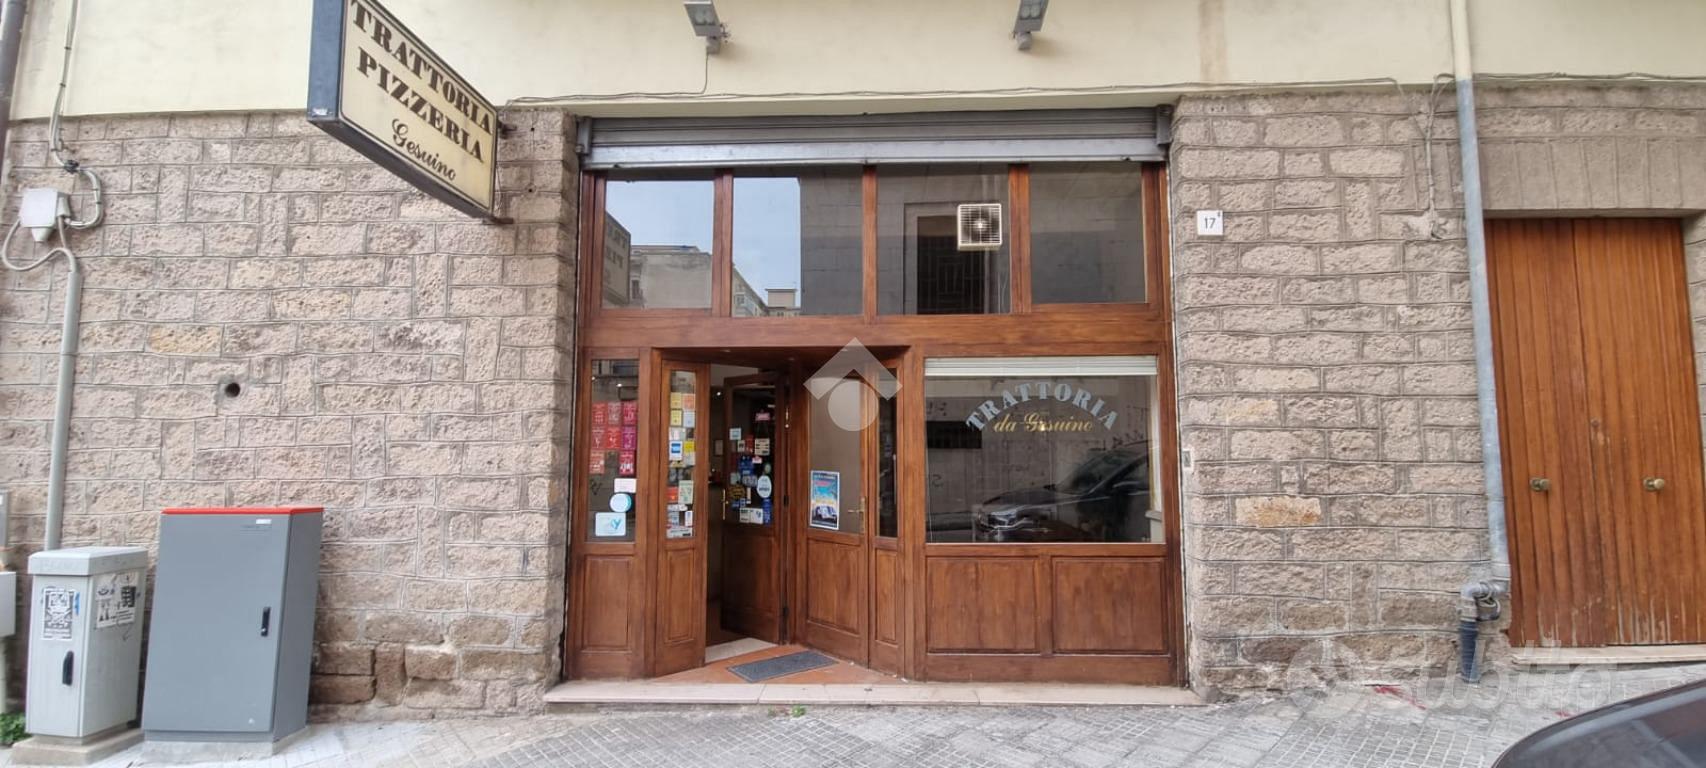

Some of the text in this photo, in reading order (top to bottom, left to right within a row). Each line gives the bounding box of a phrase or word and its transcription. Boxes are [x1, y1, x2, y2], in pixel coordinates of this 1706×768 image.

[351, 0, 492, 135] TRATTORIA
[357, 46, 485, 163] PIZZERIA
[392, 118, 456, 181] Gesuino
[966, 382, 1118, 430] TRATTORIA
[994, 413, 1017, 432] da
